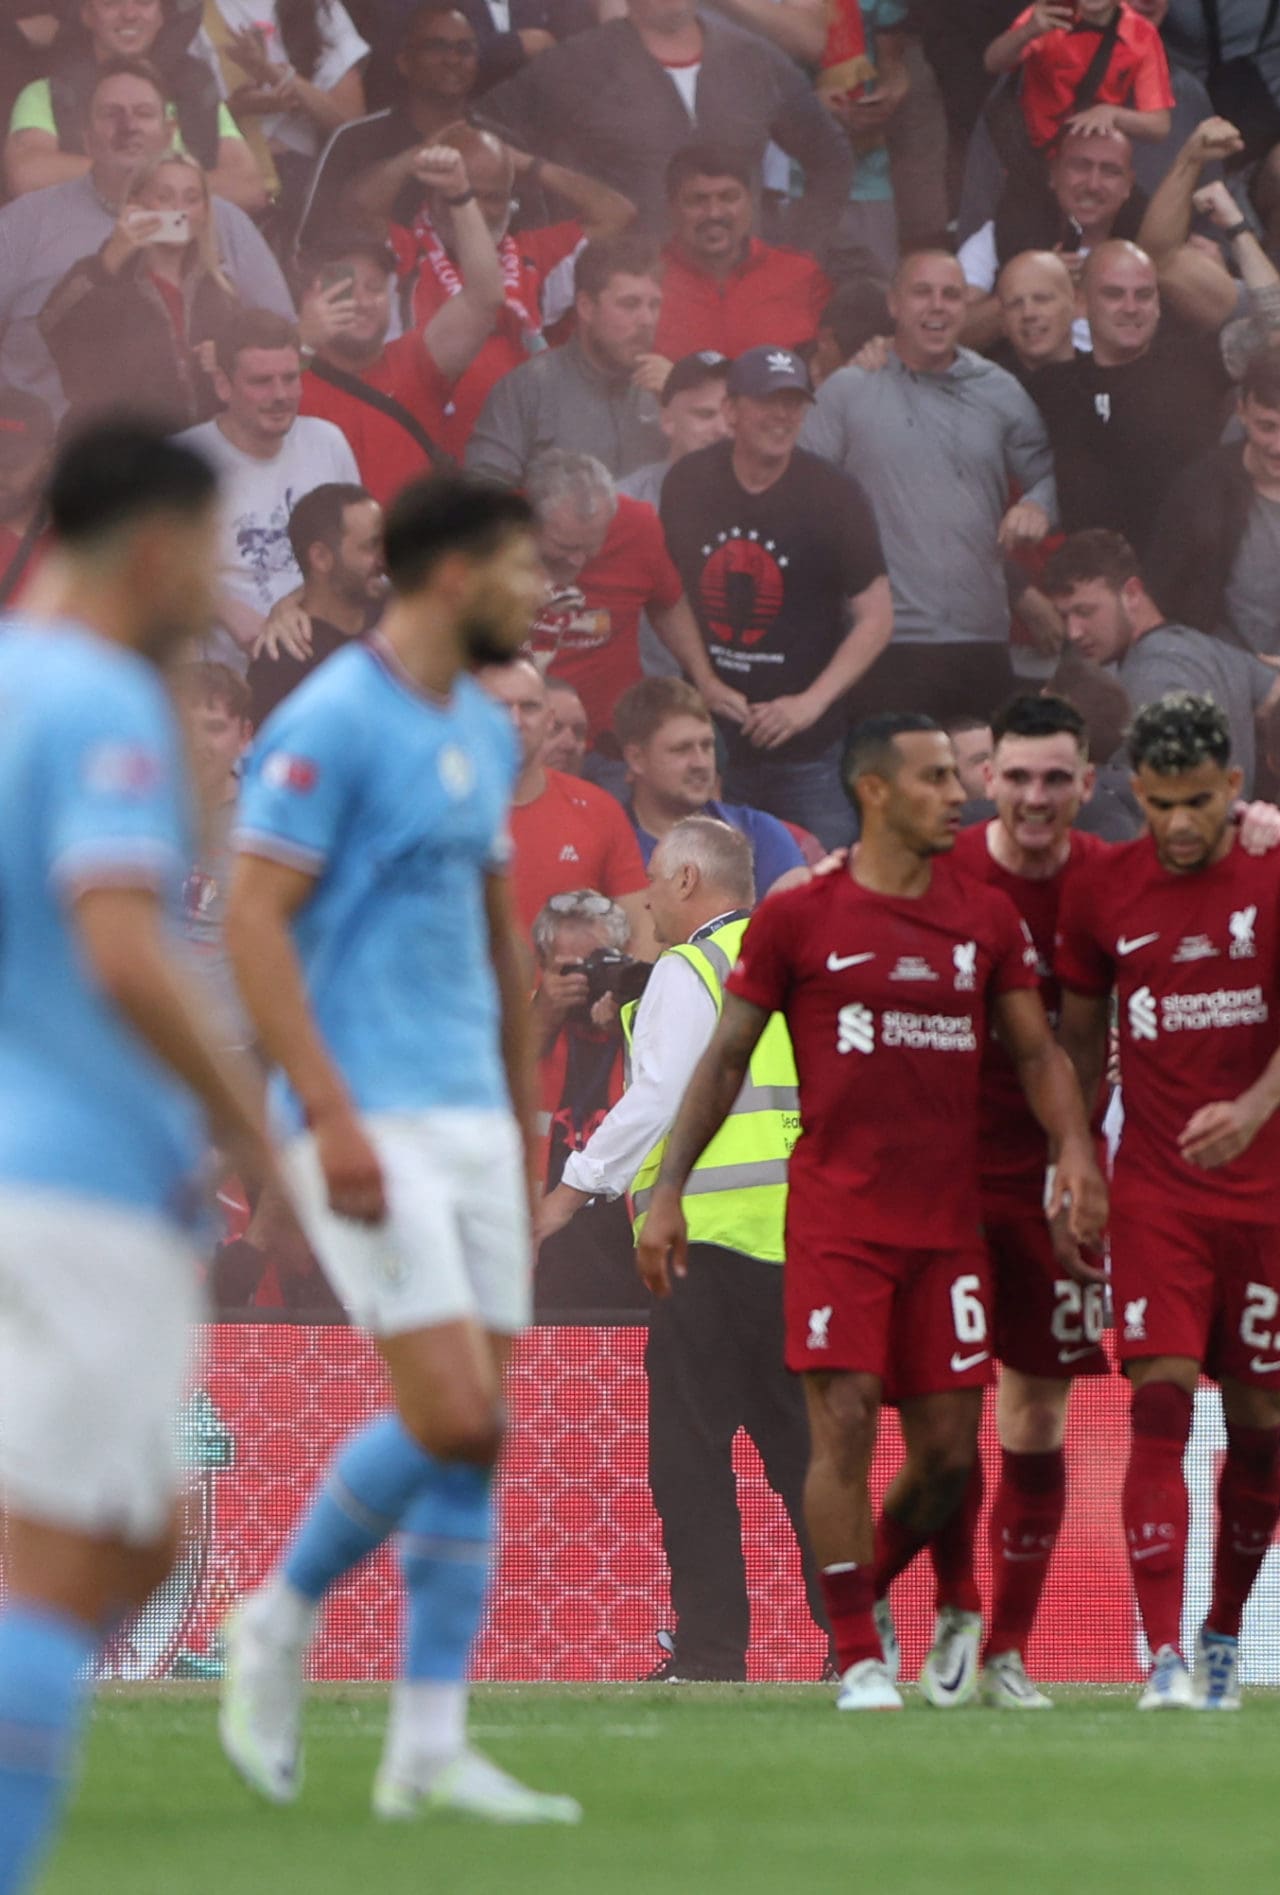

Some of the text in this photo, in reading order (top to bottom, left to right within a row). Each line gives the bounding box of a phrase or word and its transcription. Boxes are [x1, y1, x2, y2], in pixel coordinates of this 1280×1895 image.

[1161, 983, 1263, 1012] standard
[881, 1010, 973, 1033] standard
[1161, 1003, 1269, 1032] chartered
[881, 1029, 977, 1053] chartered
[951, 1274, 987, 1343] 6
